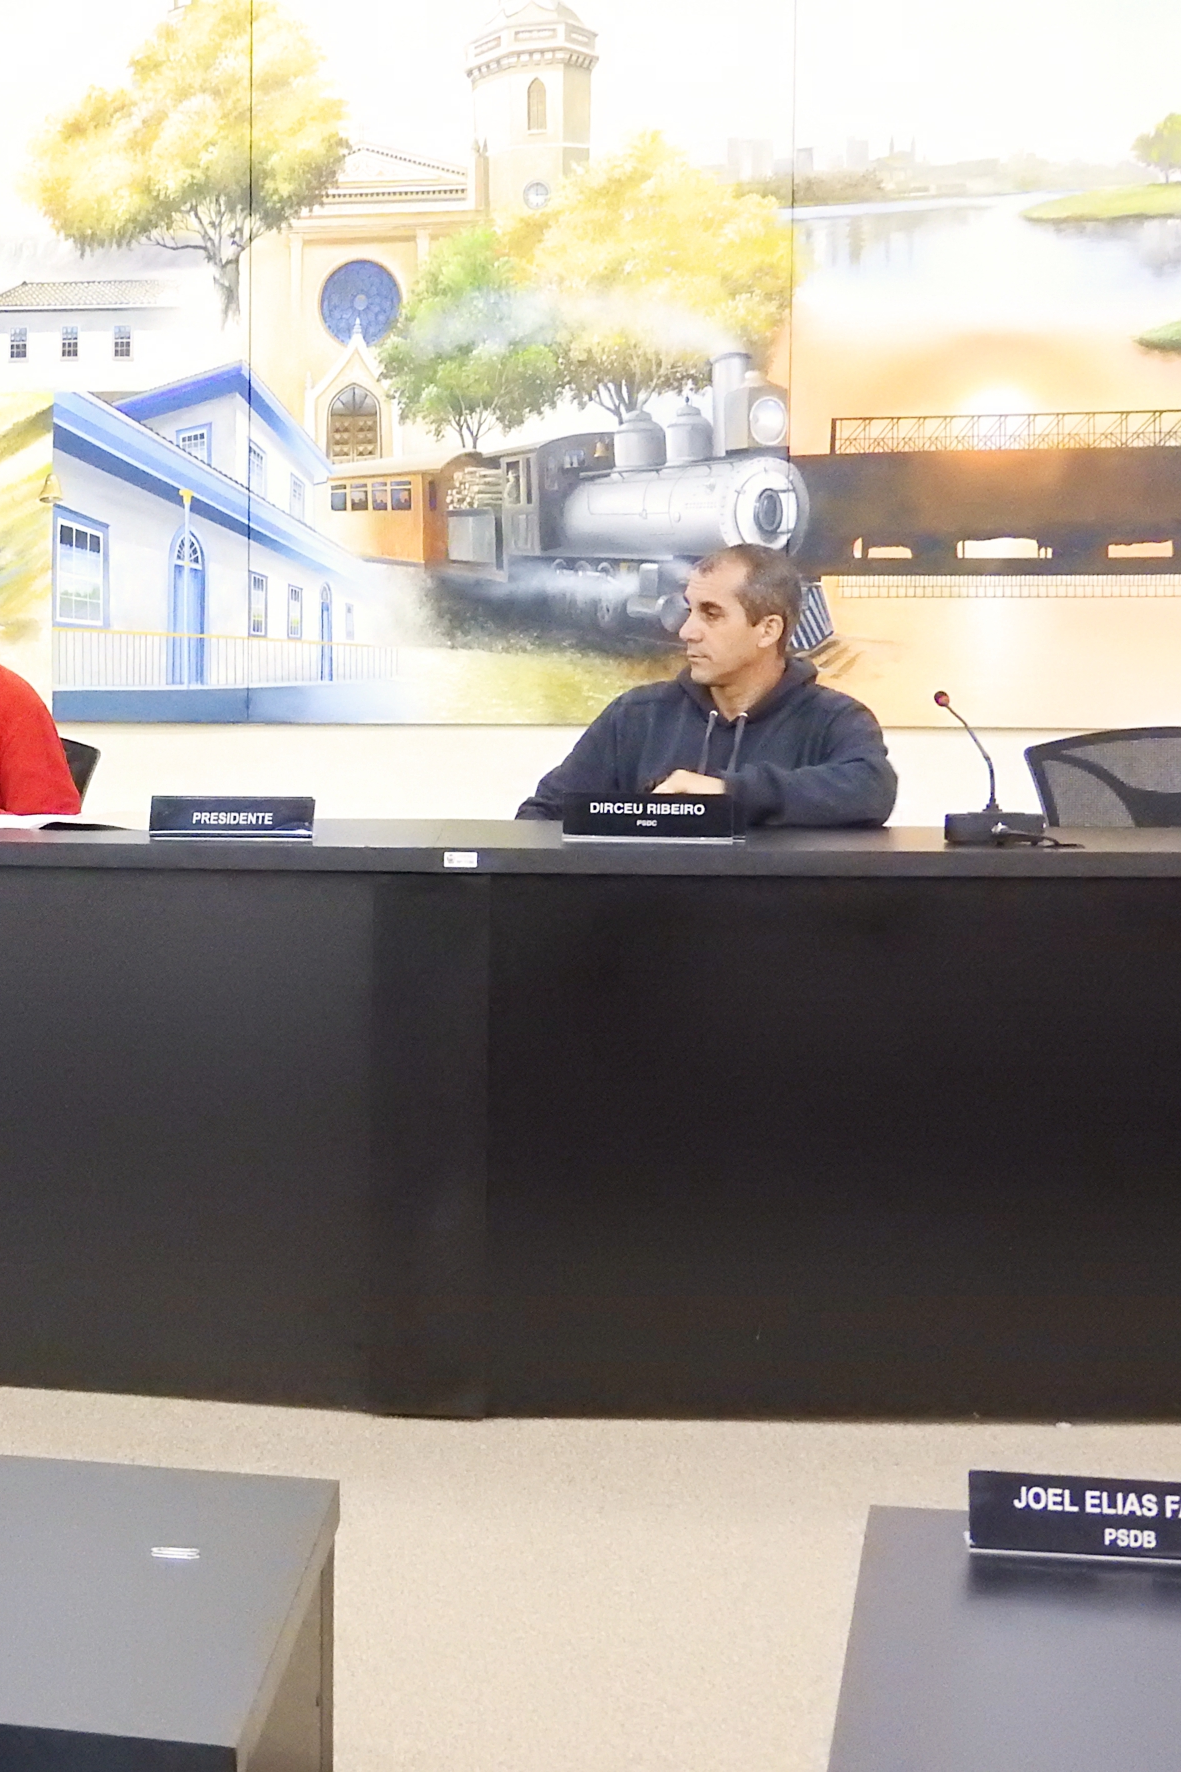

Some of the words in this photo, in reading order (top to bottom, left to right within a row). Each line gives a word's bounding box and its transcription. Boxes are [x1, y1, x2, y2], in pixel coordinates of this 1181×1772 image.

[192, 811, 274, 825] PRESIDENTE
[589, 802, 643, 815] DIRCEU
[646, 803, 706, 816] RIBEIRO
[1013, 1485, 1079, 1512] JOEL
[1084, 1489, 1159, 1518] ELIAS
[1164, 1494, 1181, 1519] F
[1103, 1527, 1157, 1549] PSDB
